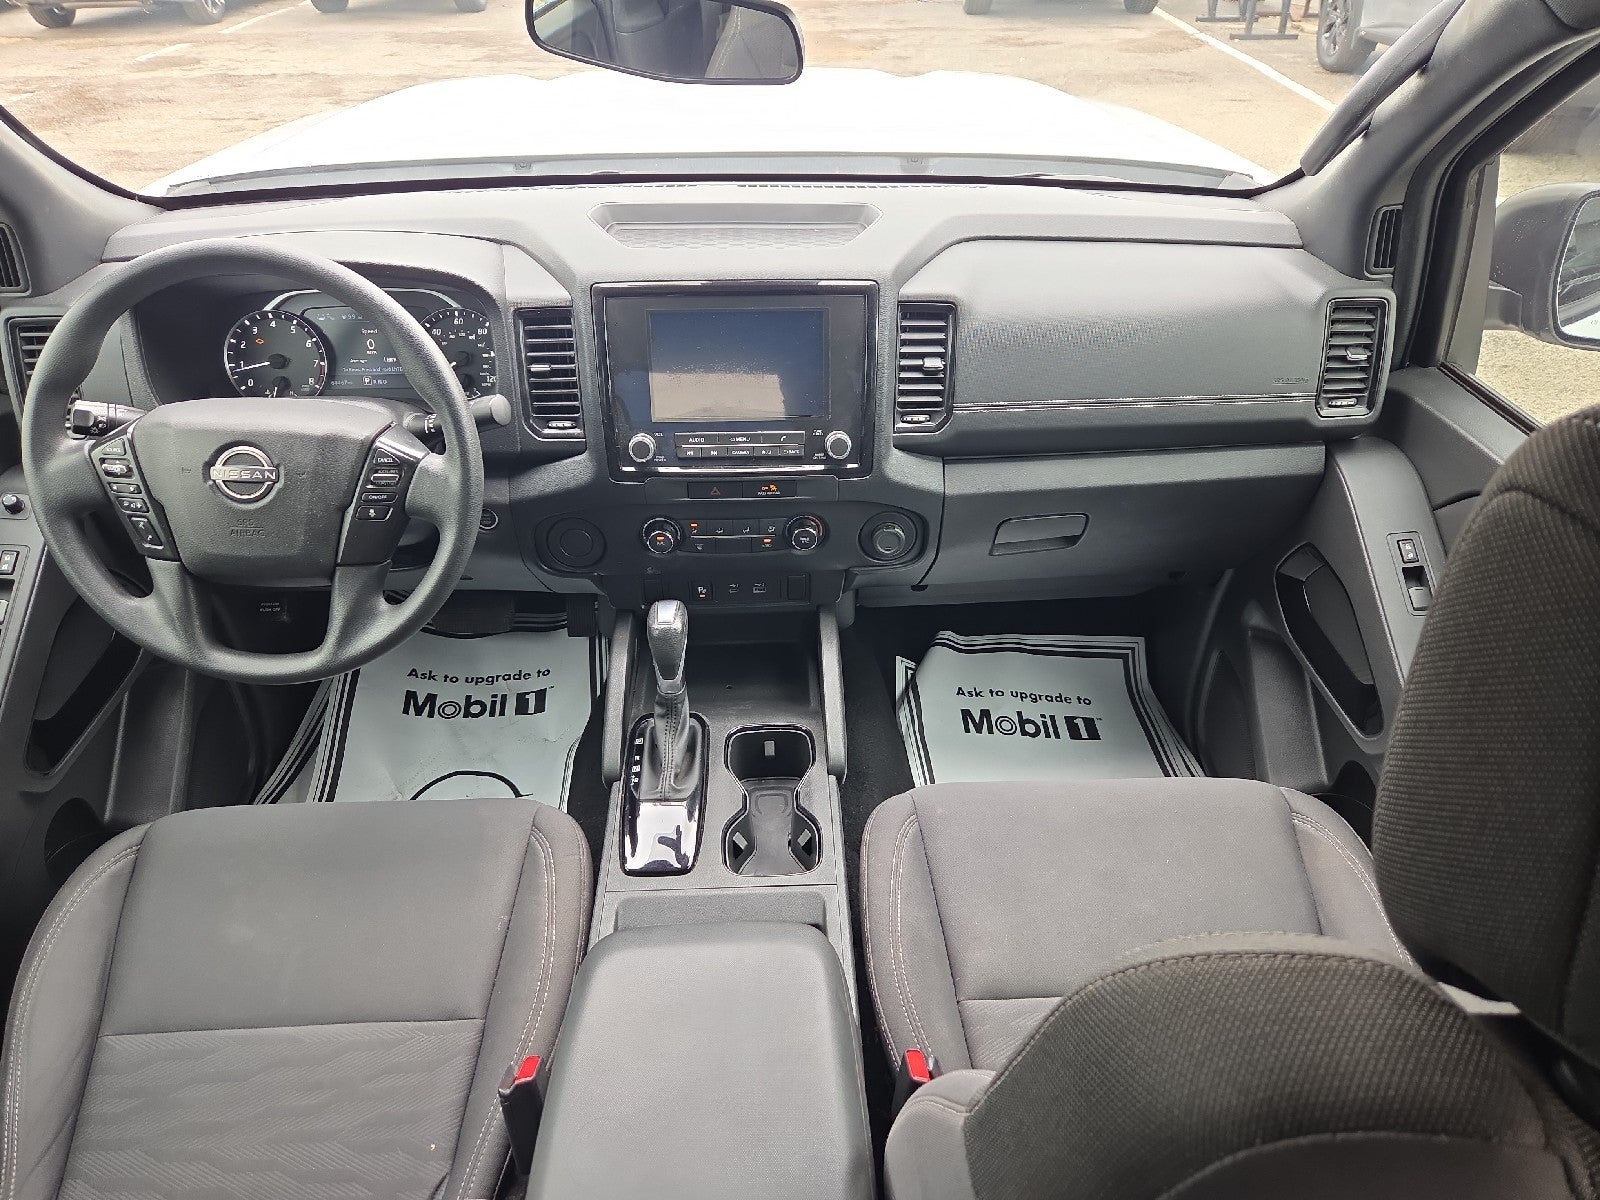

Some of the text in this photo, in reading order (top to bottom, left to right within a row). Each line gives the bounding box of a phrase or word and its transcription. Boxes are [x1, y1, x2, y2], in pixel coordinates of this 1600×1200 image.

[269, 320, 276, 328] 4
[252, 326, 258, 335] 3
[290, 326, 296, 334] 5
[240, 341, 246, 349] 2
[306, 340, 312, 348] 6
[366, 339, 375, 350] 0
[248, 379, 253, 387] 0
[212, 469, 276, 480] NISSAN
[407, 668, 551, 686] Ask to upgrade to
[956, 687, 1092, 706] Ask to upgrade to
[402, 689, 507, 719] Mobil
[960, 709, 1061, 740] Mobil
